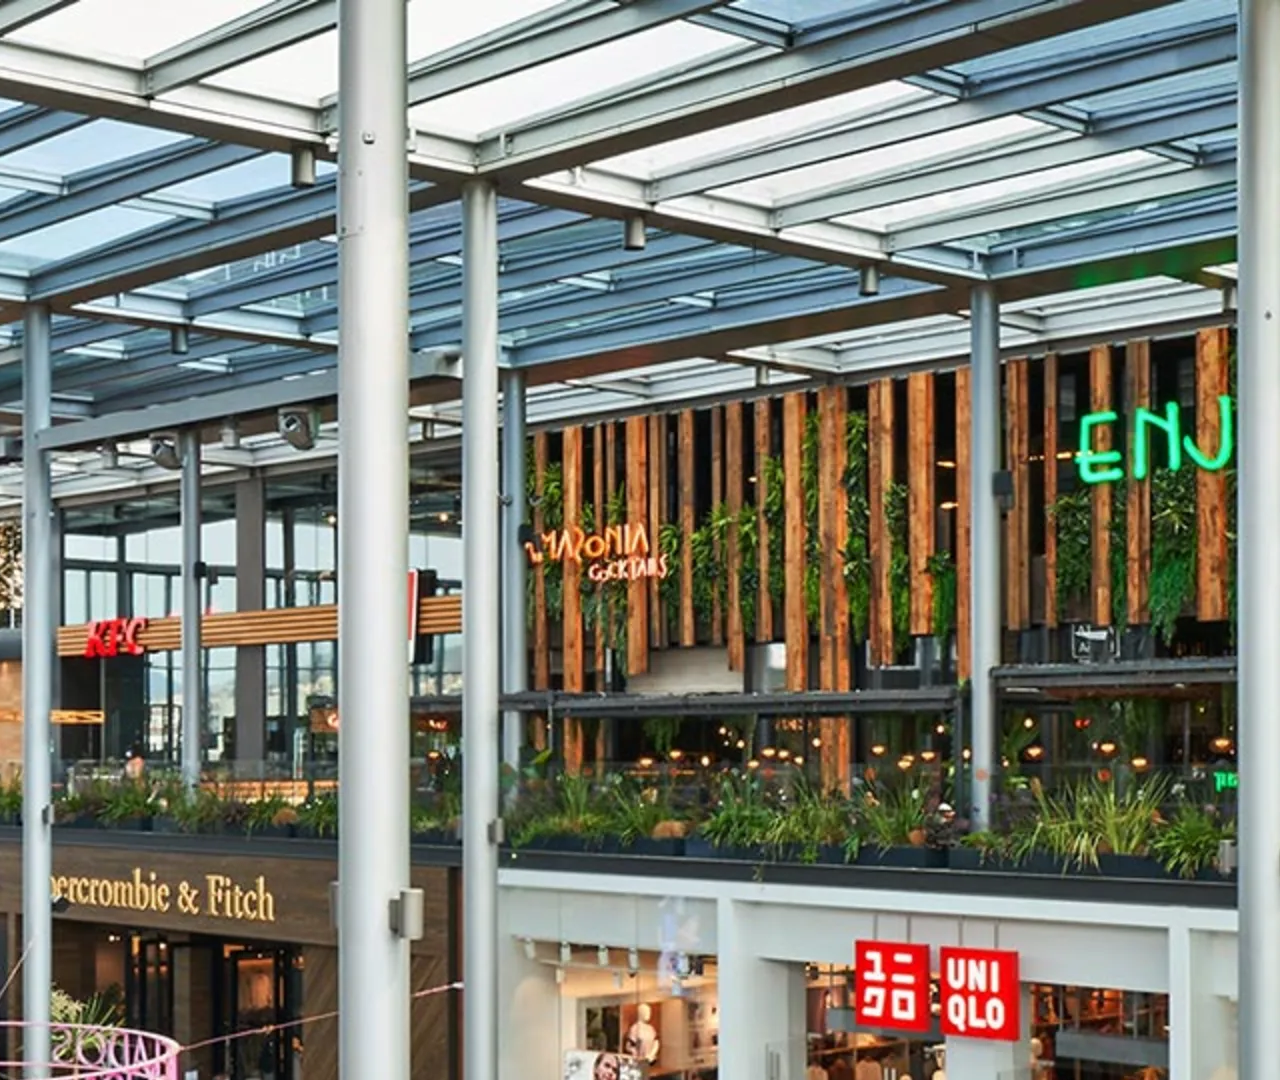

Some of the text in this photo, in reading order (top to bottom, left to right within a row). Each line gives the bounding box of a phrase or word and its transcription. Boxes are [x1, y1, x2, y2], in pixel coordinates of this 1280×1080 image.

[84, 617, 145, 657] KFC
[50, 867, 276, 922] ercrombie & Fitch
[946, 957, 999, 994] UNI
[946, 993, 1006, 1032] QLO
